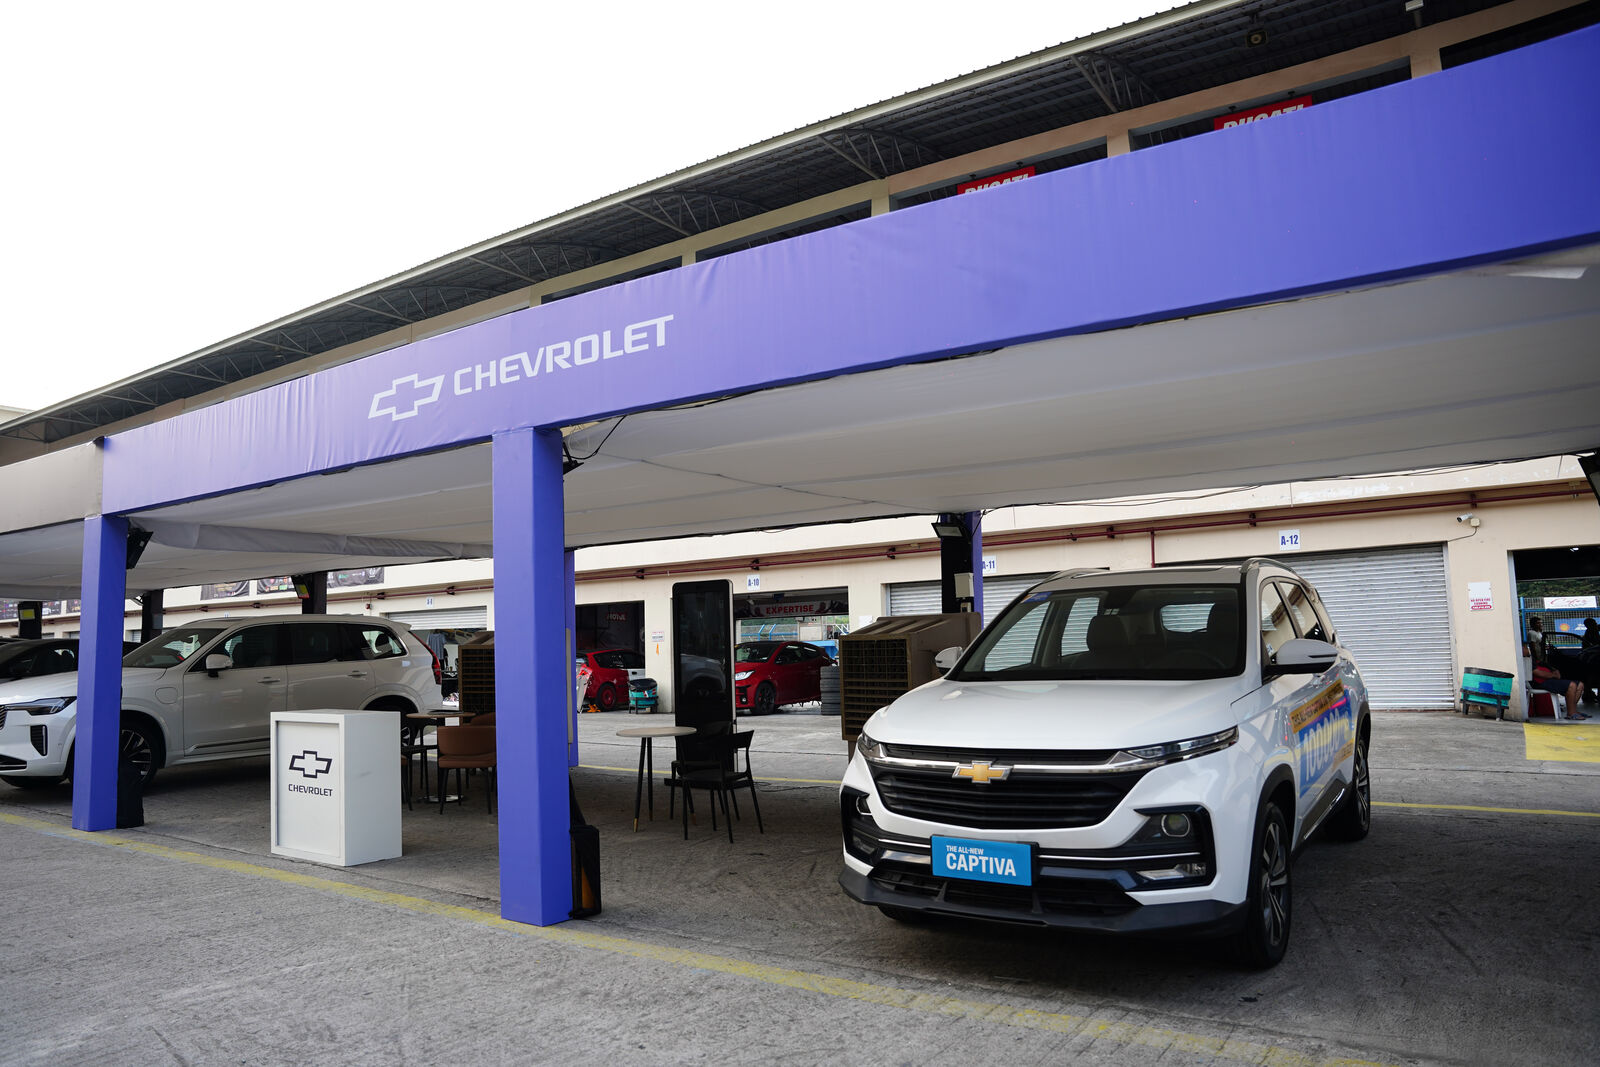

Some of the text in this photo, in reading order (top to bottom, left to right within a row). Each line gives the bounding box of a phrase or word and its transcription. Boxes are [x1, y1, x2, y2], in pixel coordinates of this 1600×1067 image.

[453, 314, 674, 396] CHEVROLET
[1281, 534, 1299, 545] A-12
[748, 578, 760, 587] A-10
[766, 604, 814, 615] EXPERTISE
[288, 783, 333, 797] CHEVROLET
[946, 845, 984, 855] THE ALL-NEW
[946, 852, 1017, 877] CAPTIVA
